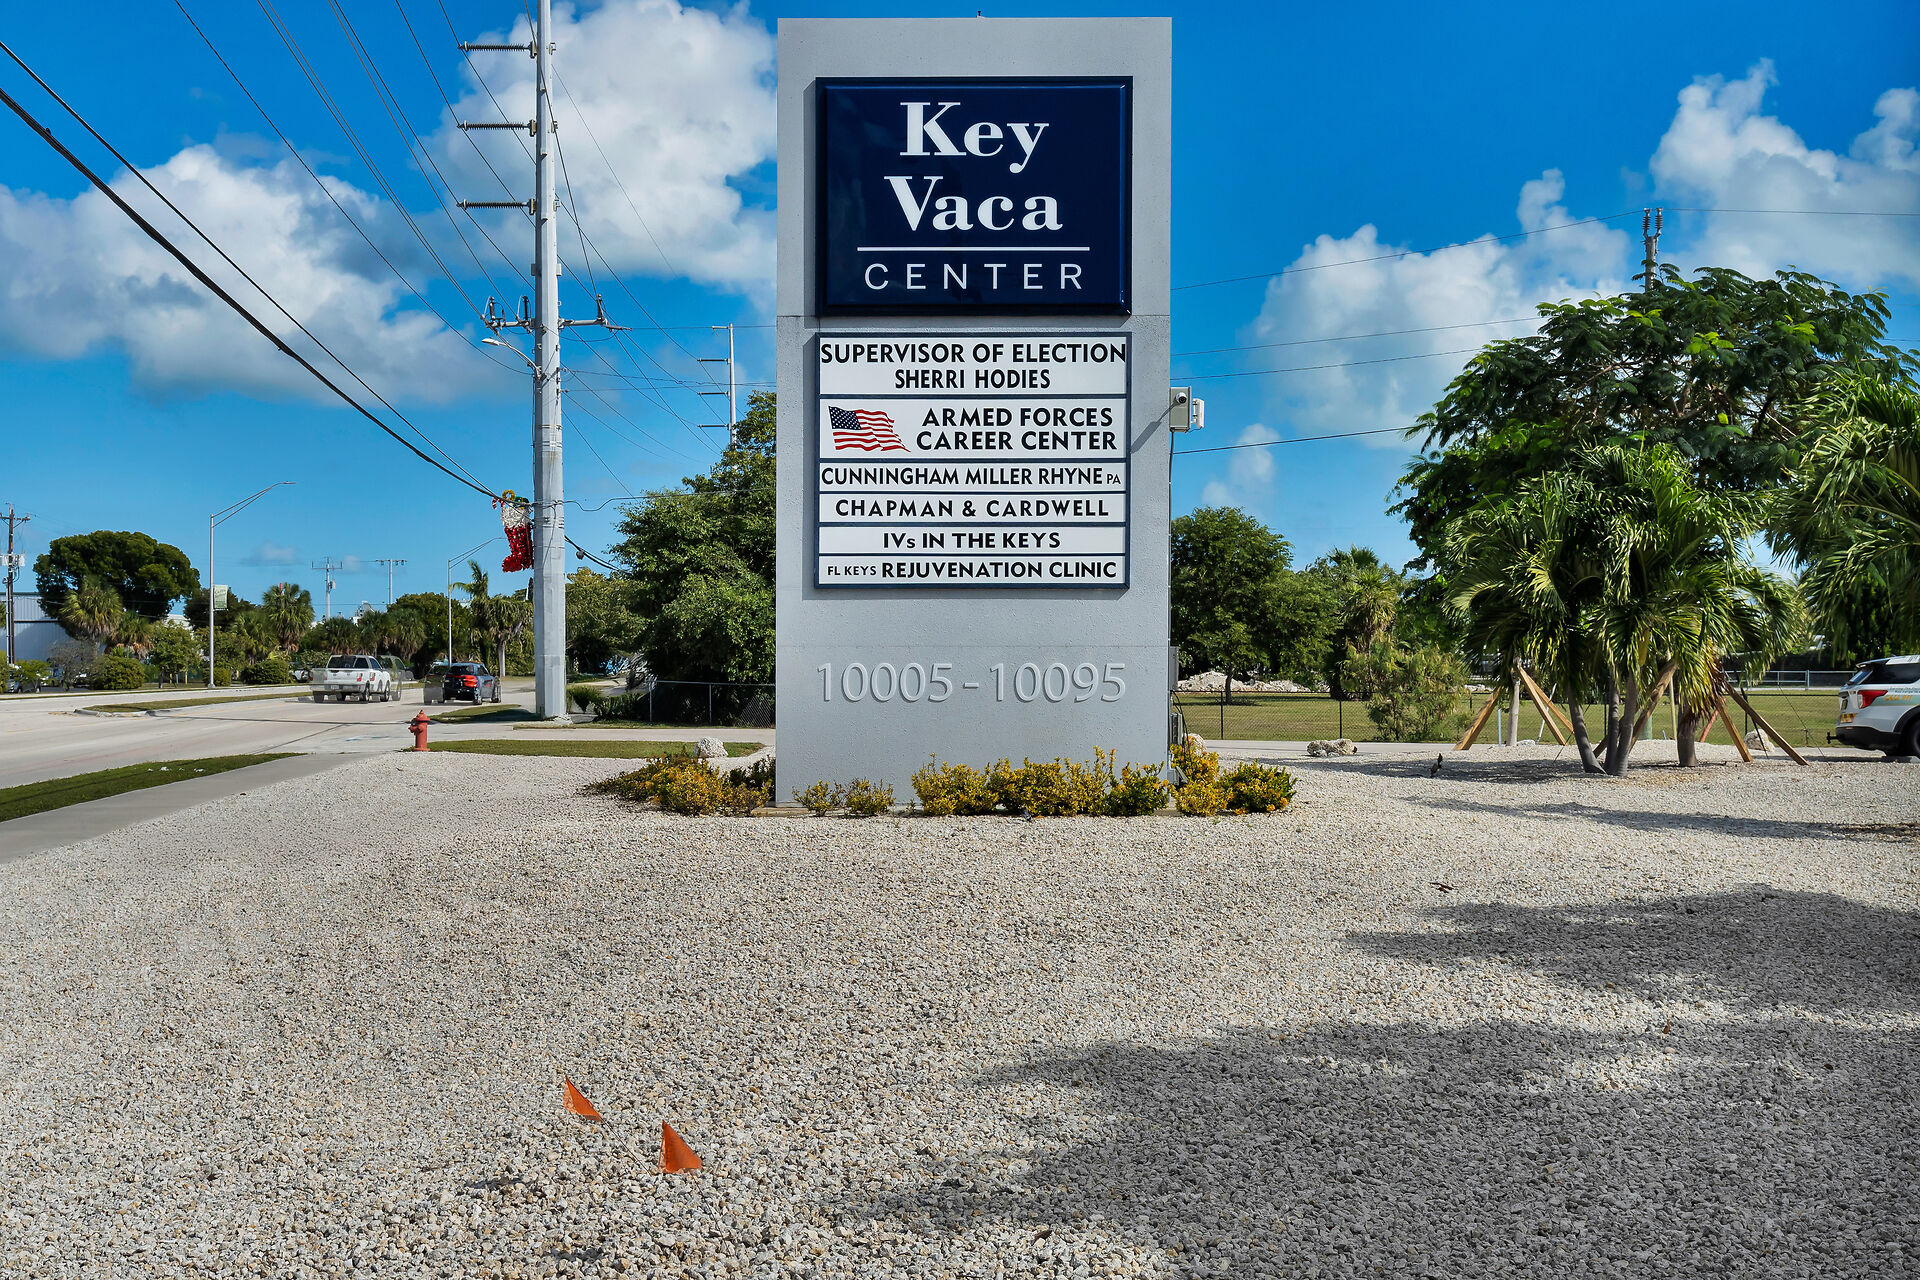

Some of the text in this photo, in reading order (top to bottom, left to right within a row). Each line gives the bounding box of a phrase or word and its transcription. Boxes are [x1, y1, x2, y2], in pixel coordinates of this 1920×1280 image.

[899, 101, 1050, 174] Key
[883, 175, 1064, 232] Vaca
[864, 262, 1082, 290] CENTER
[820, 343, 1126, 364] SUPERVISOR OF ELECTION
[895, 368, 1051, 389] SHERRI HODIES
[921, 407, 1113, 427] ARMED FORCES
[916, 430, 1118, 451] CAREER CENTER
[821, 467, 1121, 485] CUNNINGHAM MILLER RHYNE PA
[835, 499, 1109, 518] CHAPMAN & CARDWELL
[883, 531, 1061, 549] IVs IN THE KEYS
[827, 561, 1117, 579] FL KEYS REJUVENATION CLINIC
